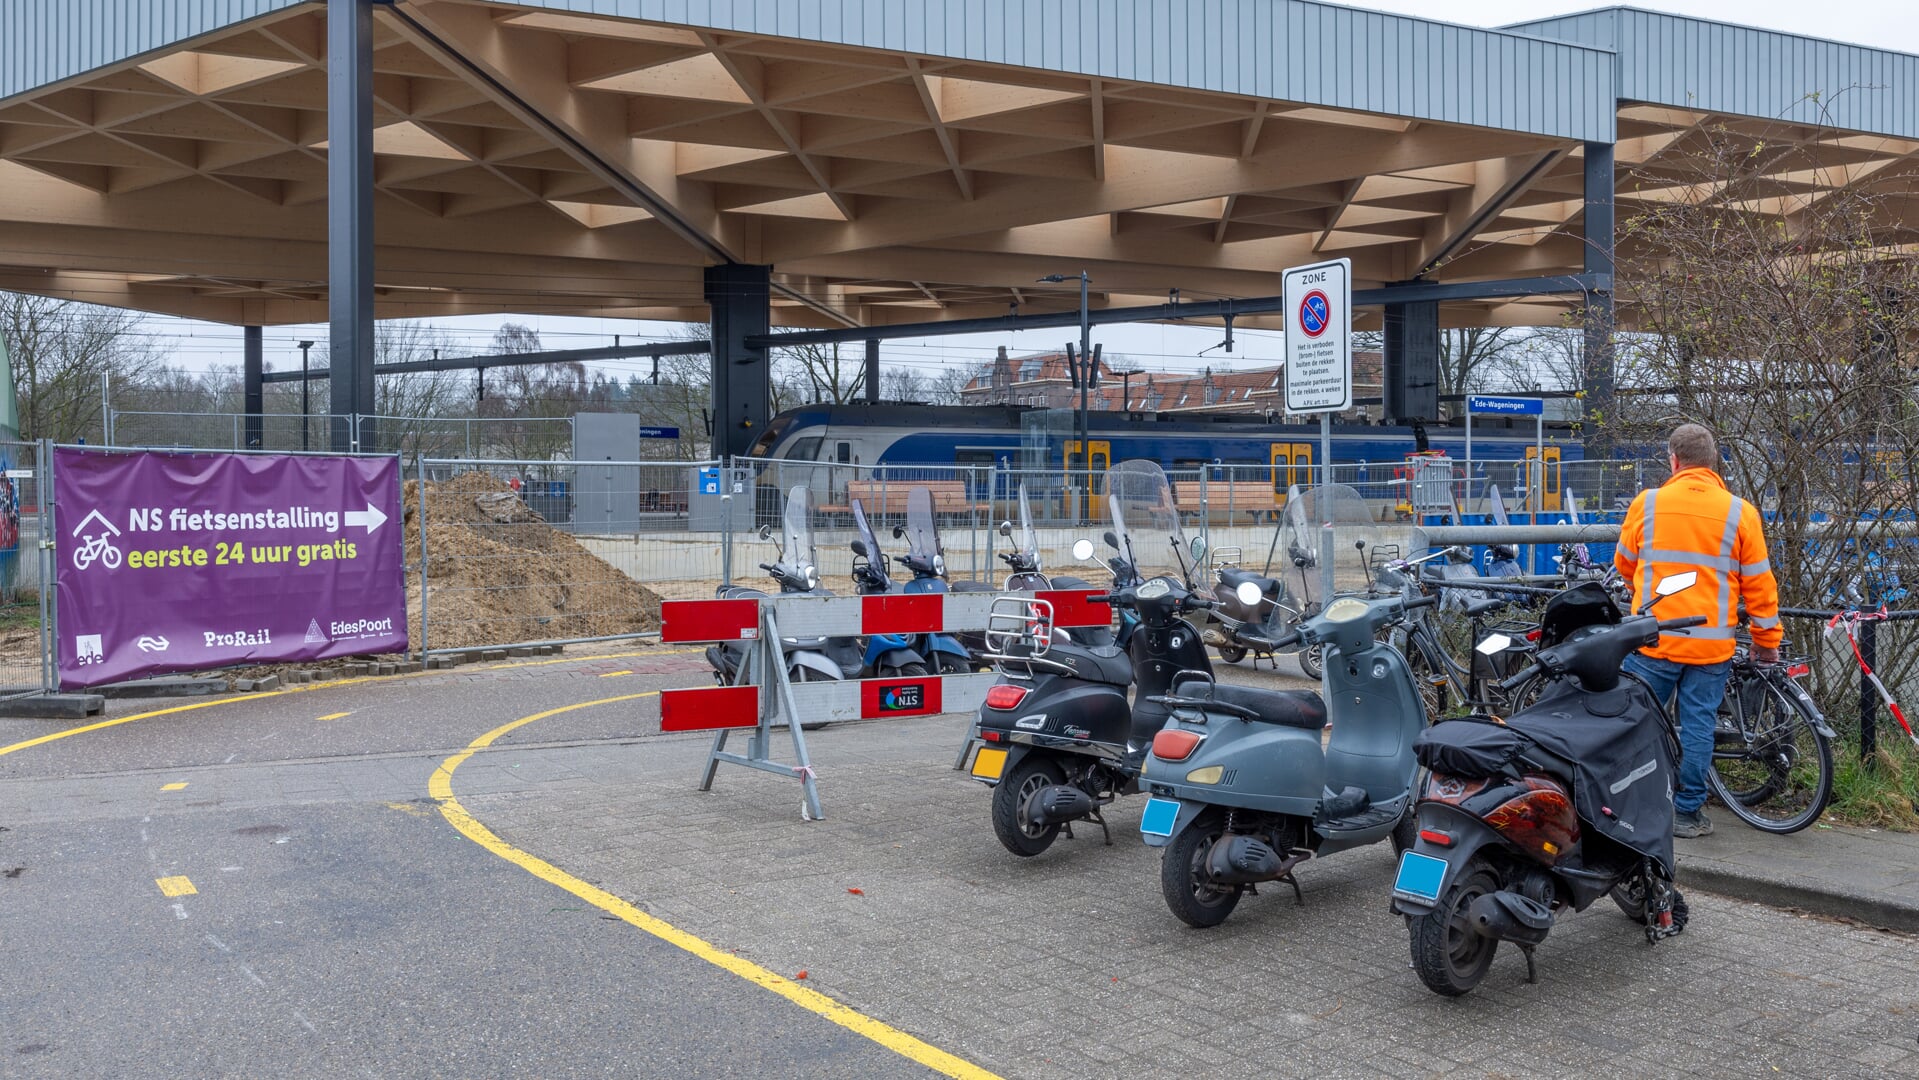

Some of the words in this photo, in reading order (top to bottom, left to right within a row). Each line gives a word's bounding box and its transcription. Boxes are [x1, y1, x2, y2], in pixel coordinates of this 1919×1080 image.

[1302, 272, 1326, 285] ZONE
[1312, 341, 1335, 349] verboden
[1317, 349, 1334, 357] fietsen
[1312, 377, 1342, 387] parkeerduur
[1475, 400, 1525, 410] Ede-Wageningen
[1001, 455, 1007, 469] 1
[1359, 458, 1367, 471] 2
[129, 508, 163, 532] NS
[169, 507, 339, 532] fietsenstalling
[128, 545, 209, 568] eerste
[215, 542, 245, 565] 24
[251, 545, 292, 564] uur
[297, 538, 357, 566] gratis
[331, 617, 392, 635] EdesPoort
[204, 629, 271, 647] ProRail
[78, 650, 103, 666] ede
[898, 695, 918, 706] STN
